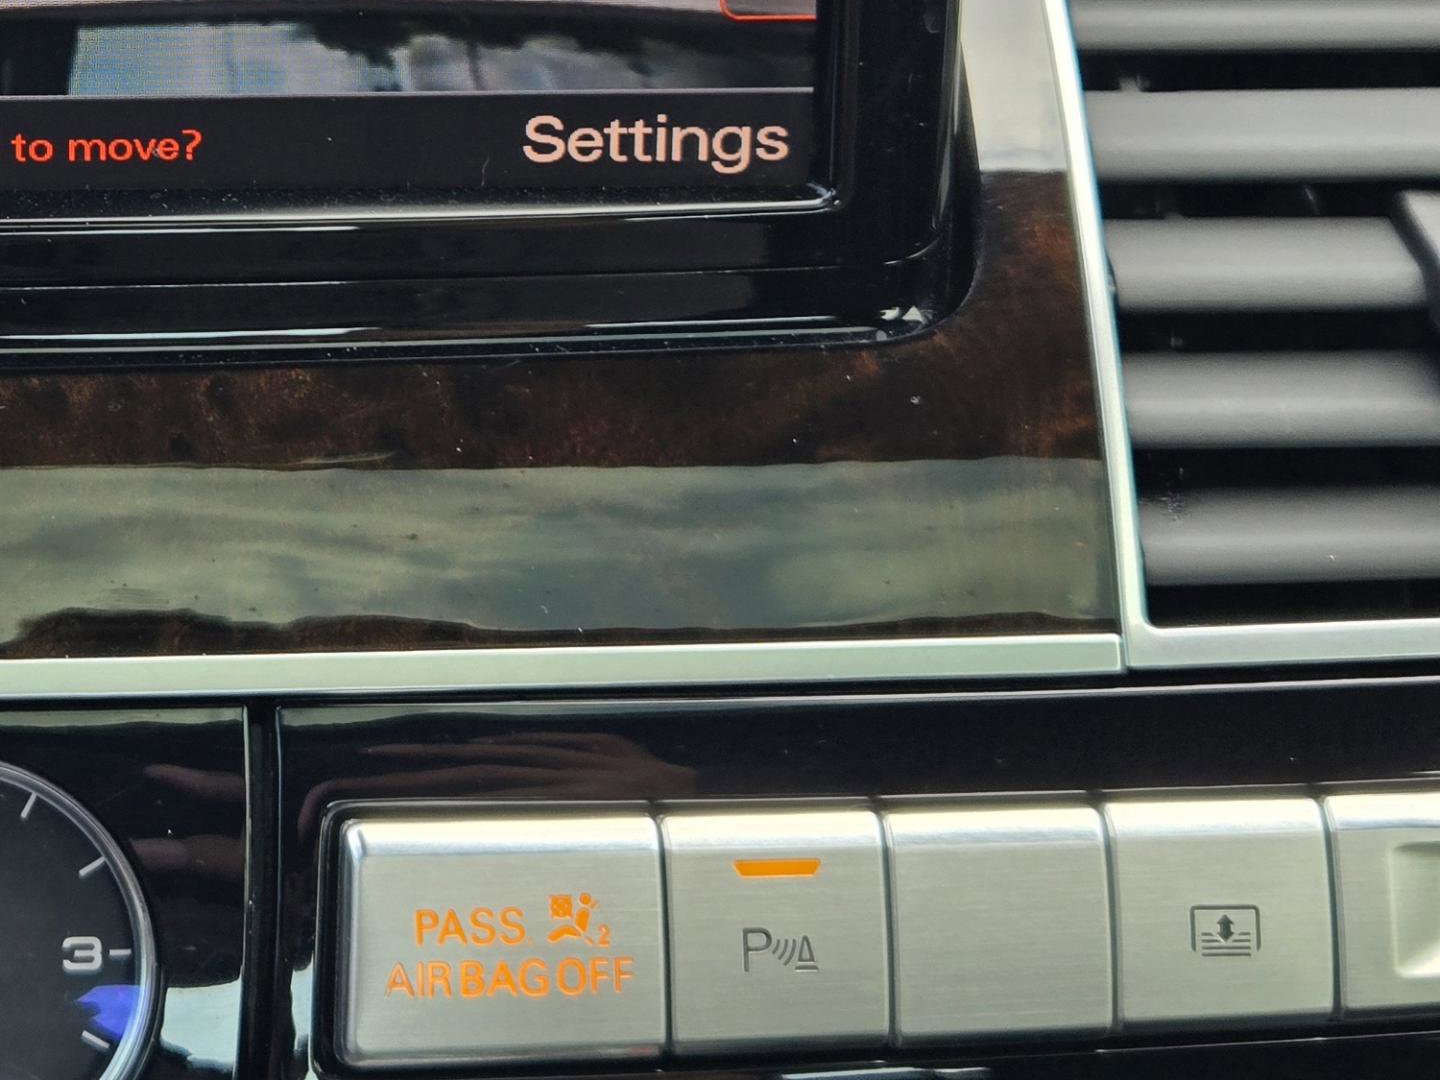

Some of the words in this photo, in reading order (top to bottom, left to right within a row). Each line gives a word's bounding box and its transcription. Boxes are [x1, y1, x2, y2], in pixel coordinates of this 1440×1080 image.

[11, 133, 54, 162] to
[68, 129, 203, 161] move?
[522, 114, 790, 174] Settings
[63, 936, 103, 973] 3
[558, 956, 634, 996] OFF
